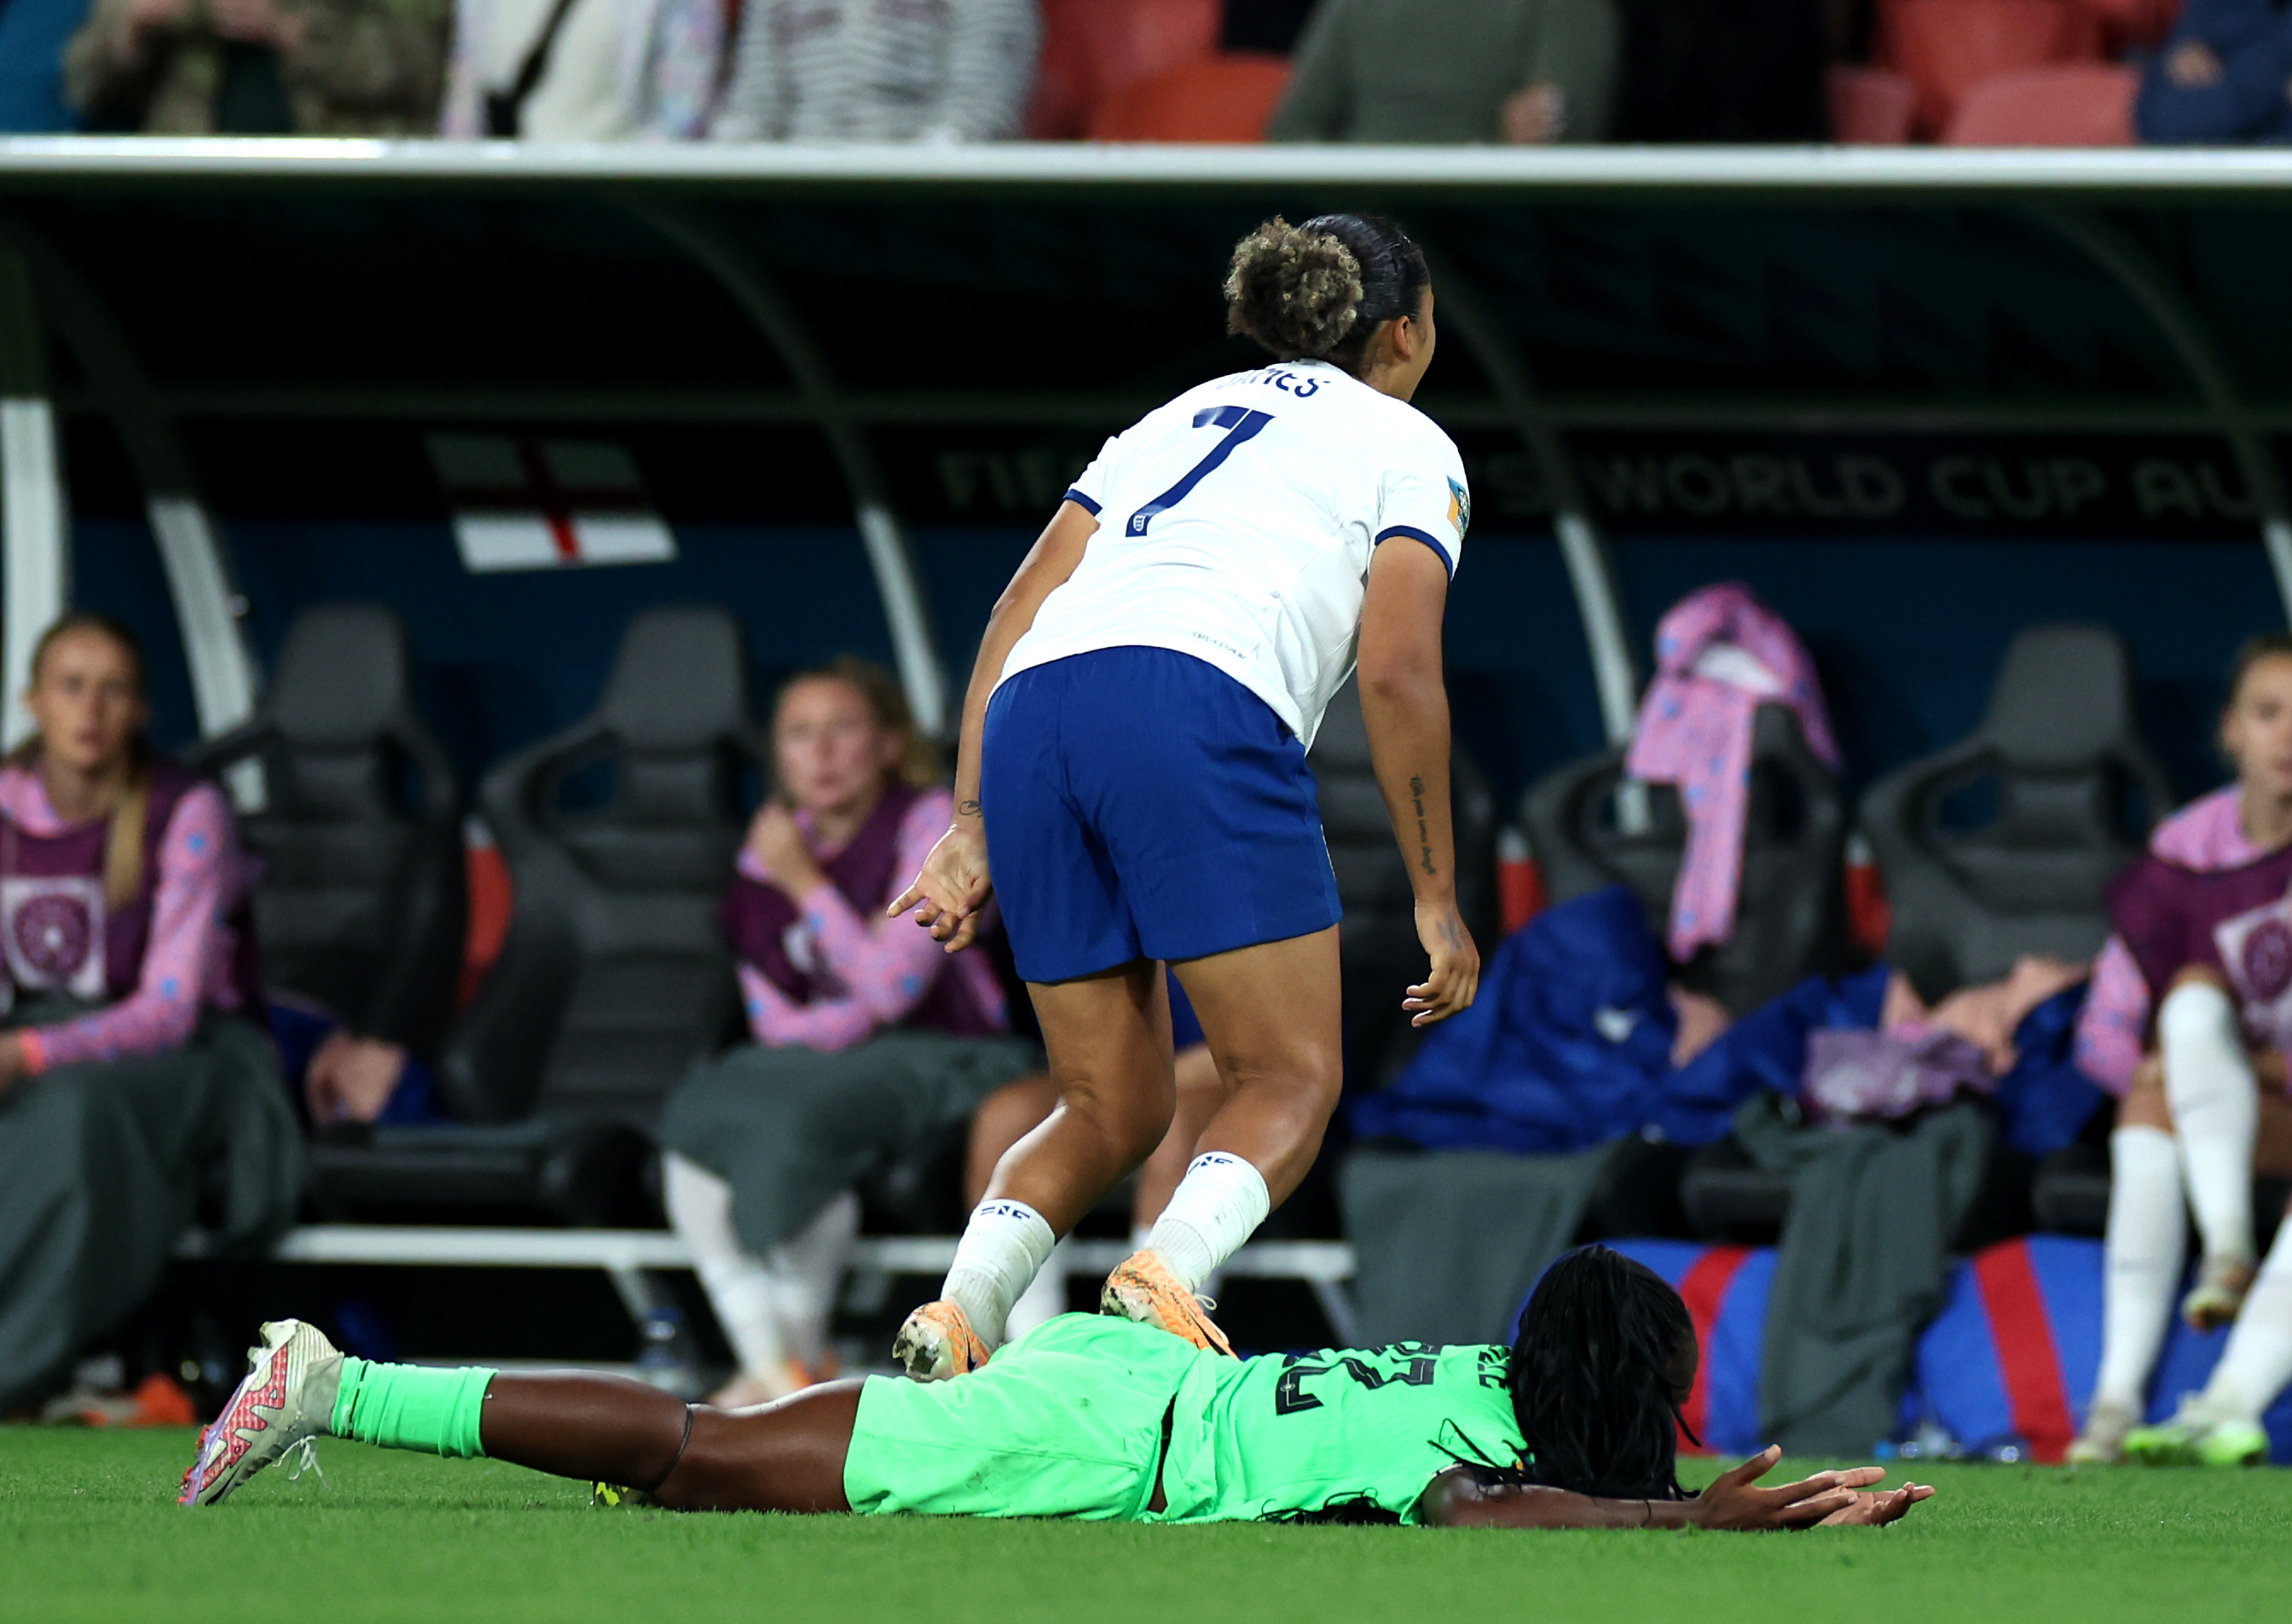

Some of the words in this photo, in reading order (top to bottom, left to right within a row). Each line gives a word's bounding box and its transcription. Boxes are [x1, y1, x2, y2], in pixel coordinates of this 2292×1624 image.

[1215, 367, 1332, 398] JAMES
[1126, 405, 1276, 538] 7
[1579, 450, 1909, 519] WORLD
[1925, 454, 2110, 522] CUP
